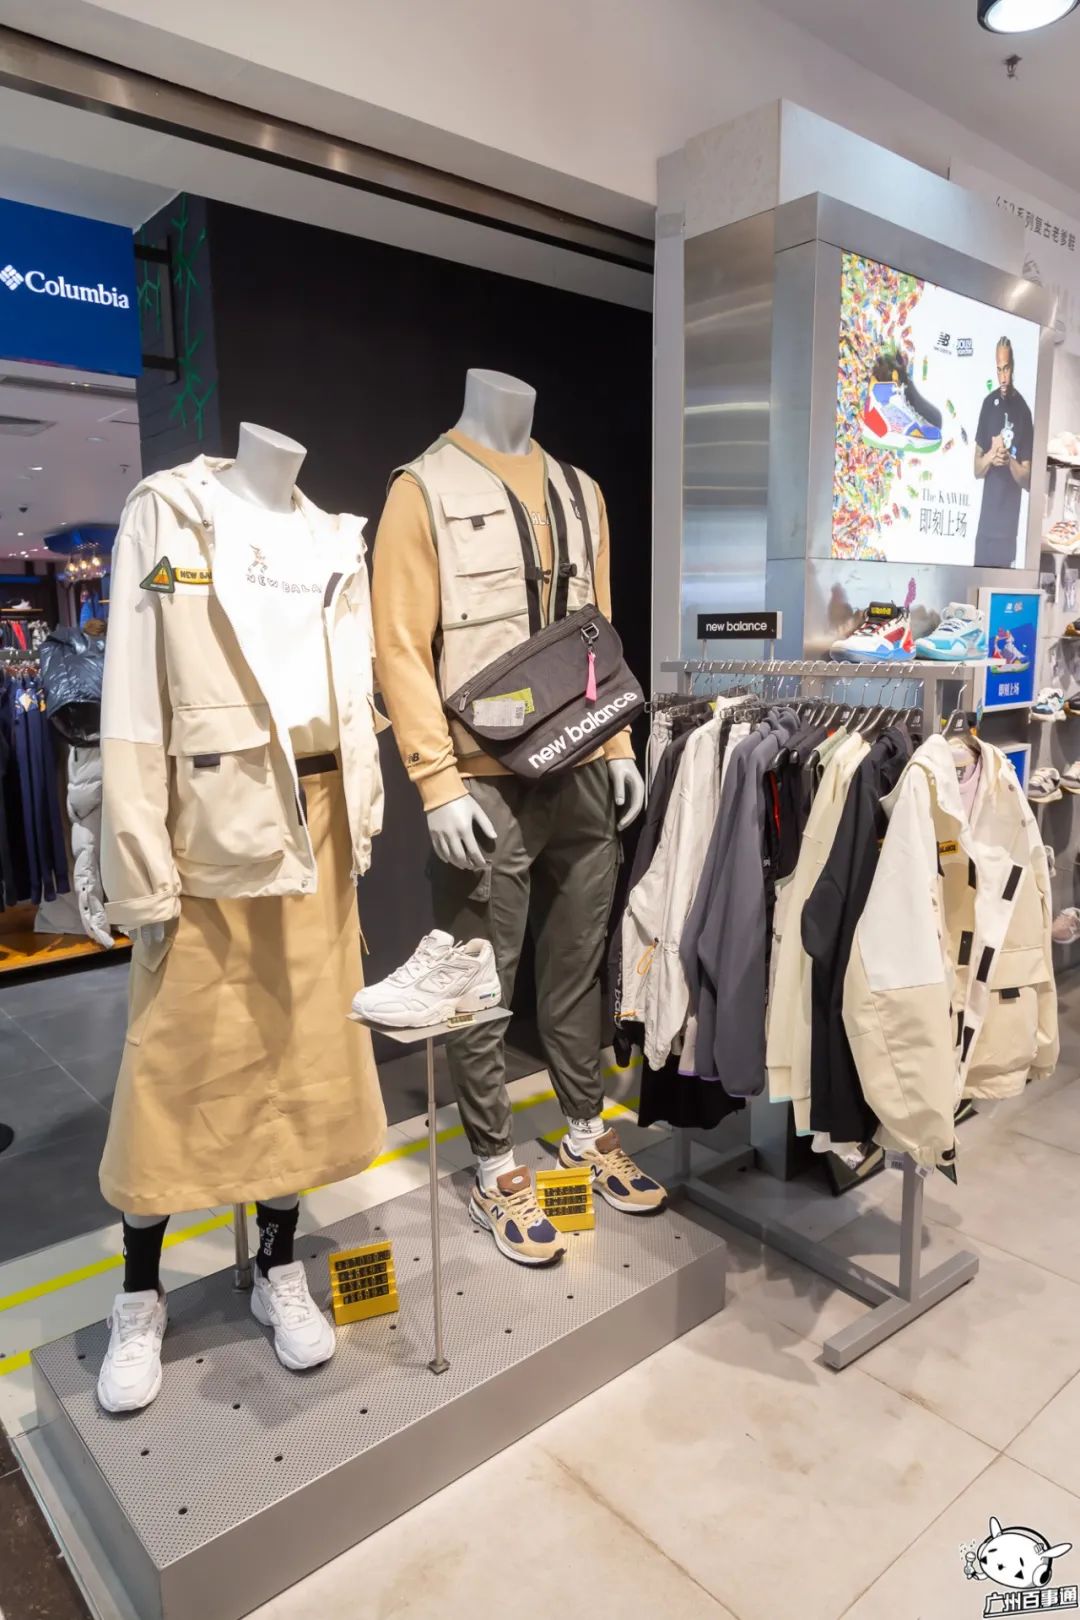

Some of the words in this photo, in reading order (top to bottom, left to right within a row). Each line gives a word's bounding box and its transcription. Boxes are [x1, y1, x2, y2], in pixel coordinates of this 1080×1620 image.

[25, 270, 130, 309] Columbia
[920, 508, 967, 538] 即刻上场
[180, 570, 197, 579] NEW
[706, 623, 725, 631] new
[726, 620, 768, 632] balance
[528, 735, 567, 769] new
[564, 692, 638, 742] balance
